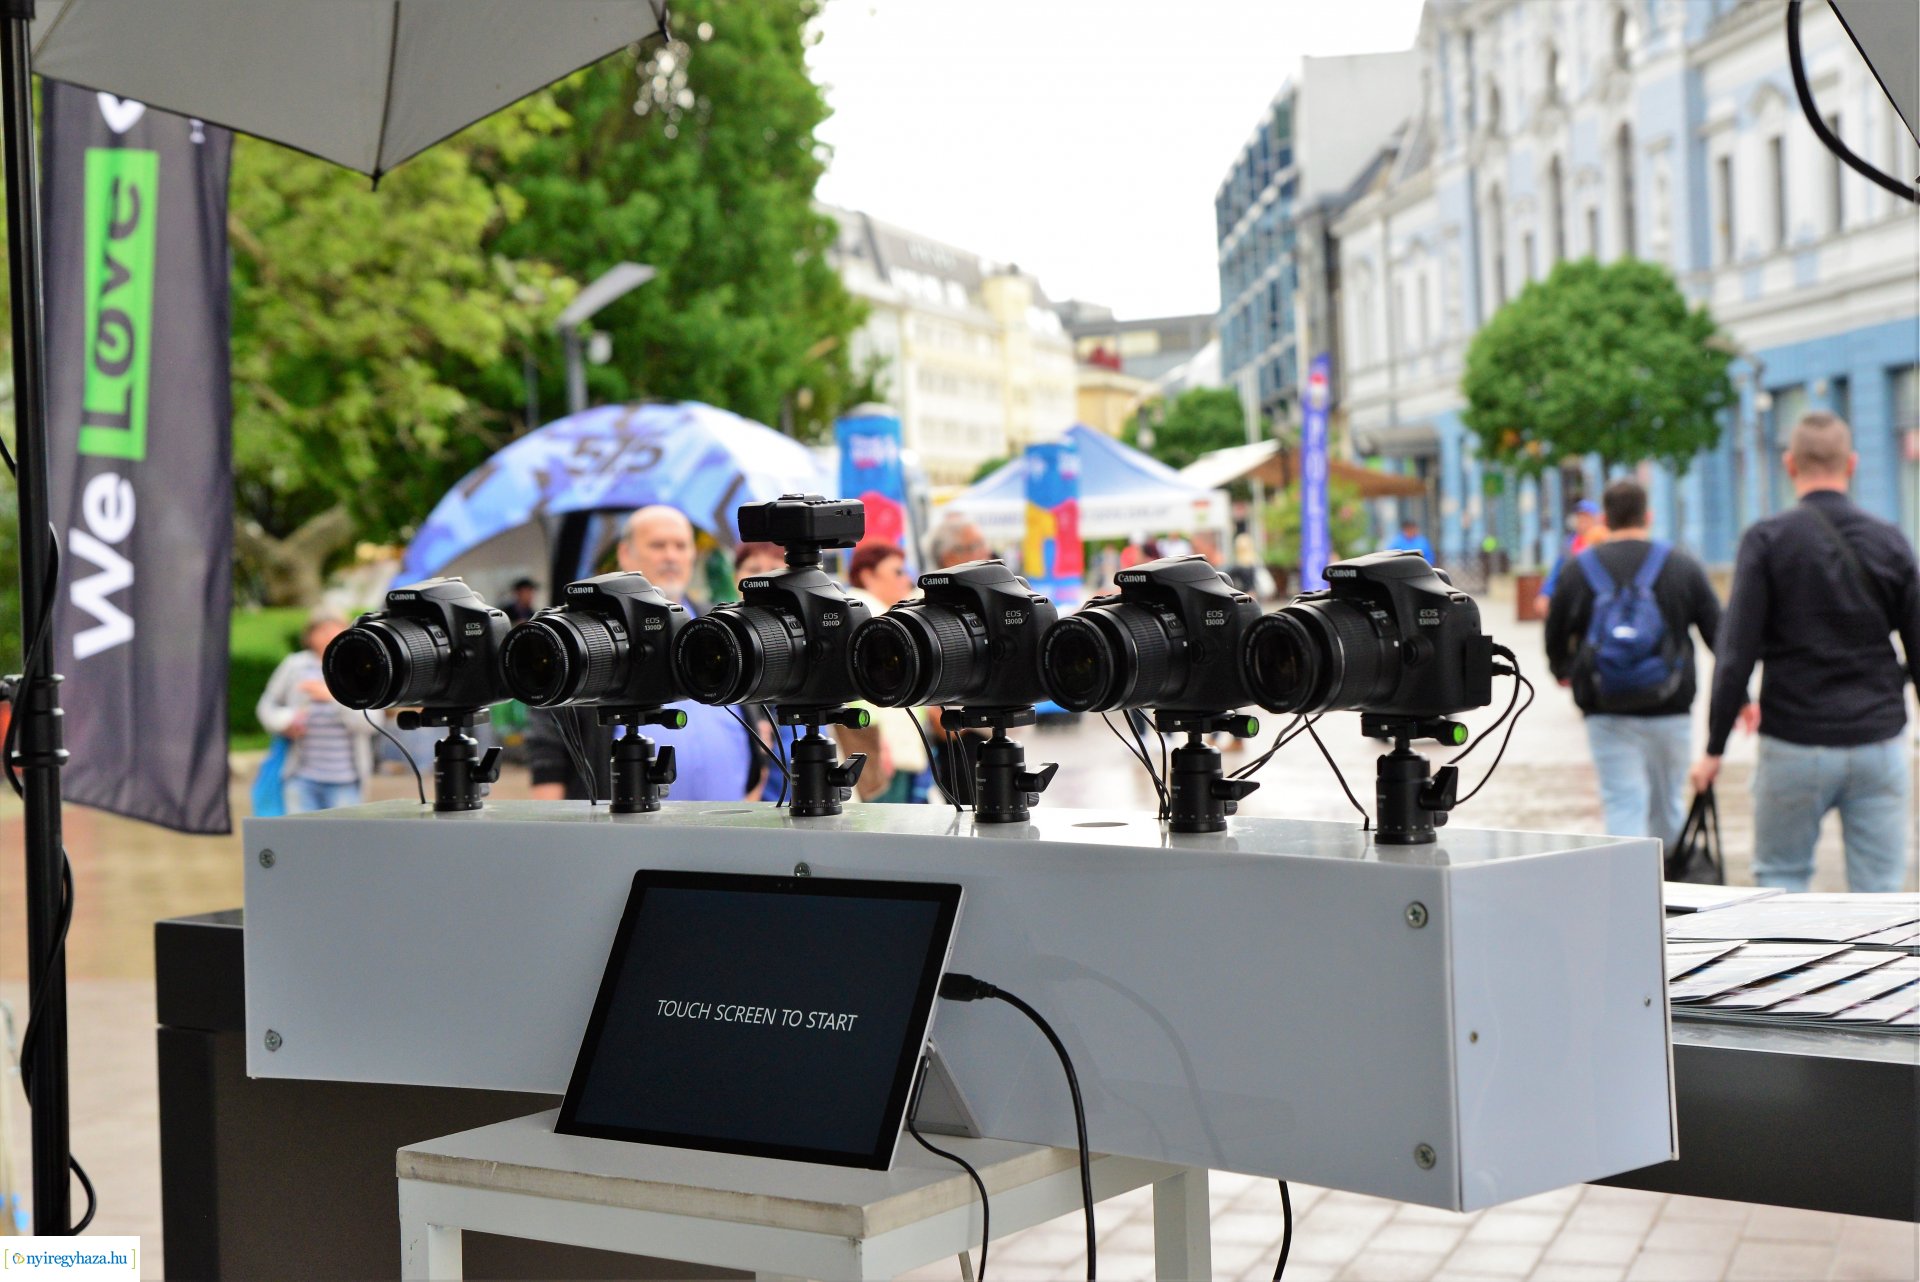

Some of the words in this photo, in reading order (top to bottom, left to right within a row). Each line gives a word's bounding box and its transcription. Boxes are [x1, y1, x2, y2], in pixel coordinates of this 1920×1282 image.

[82, 175, 143, 433] Love
[70, 472, 136, 660] We
[1326, 569, 1357, 577] Canon
[922, 577, 949, 585] Canon
[1118, 574, 1146, 582] Canon
[742, 580, 769, 589] Canon
[567, 586, 594, 594] Canon
[389, 593, 416, 601] Canon
[657, 999, 712, 1020] TOUCH
[714, 1004, 777, 1025] SCREEN
[782, 1009, 803, 1027] TO
[805, 1011, 858, 1031] START
